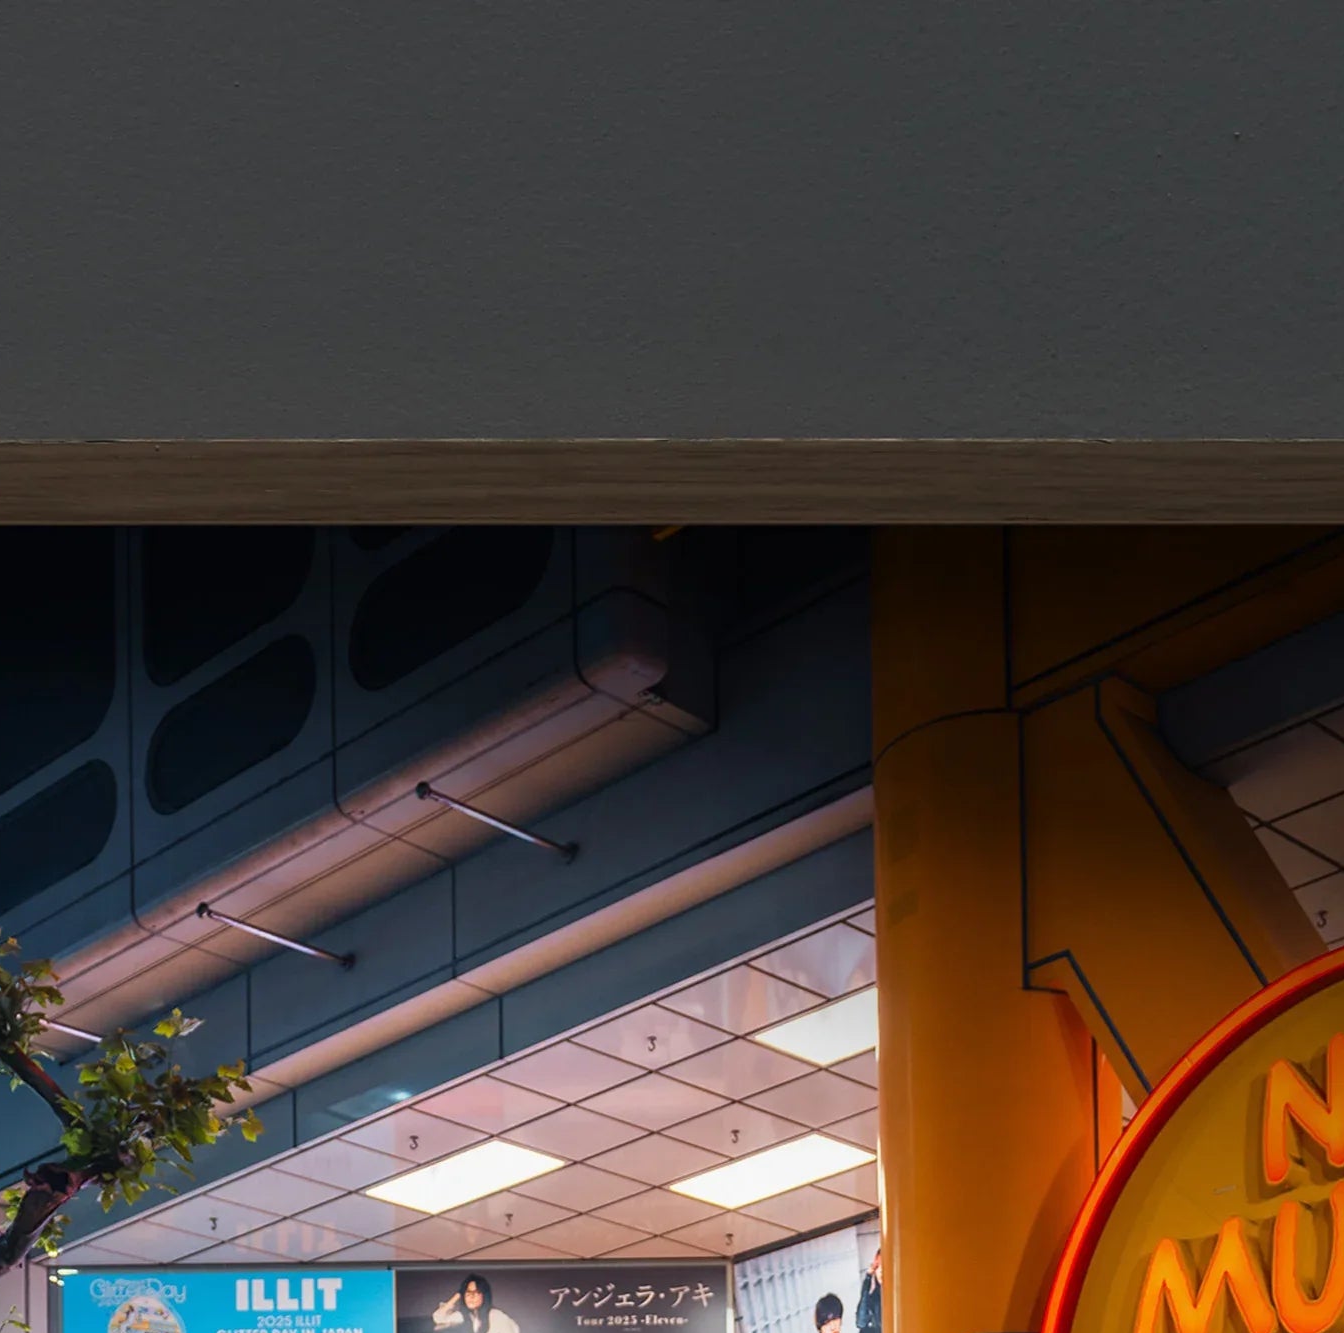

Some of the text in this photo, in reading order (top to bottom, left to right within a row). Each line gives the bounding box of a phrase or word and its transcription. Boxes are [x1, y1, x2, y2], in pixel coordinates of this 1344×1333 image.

[236, 1278, 343, 1311] ILLIT
[549, 1283, 714, 1310] アンジェラ・アキ
[257, 1315, 322, 1327] 2025 ILLIT
[576, 1315, 604, 1326] Tour
[607, 1314, 637, 1326] 2025
